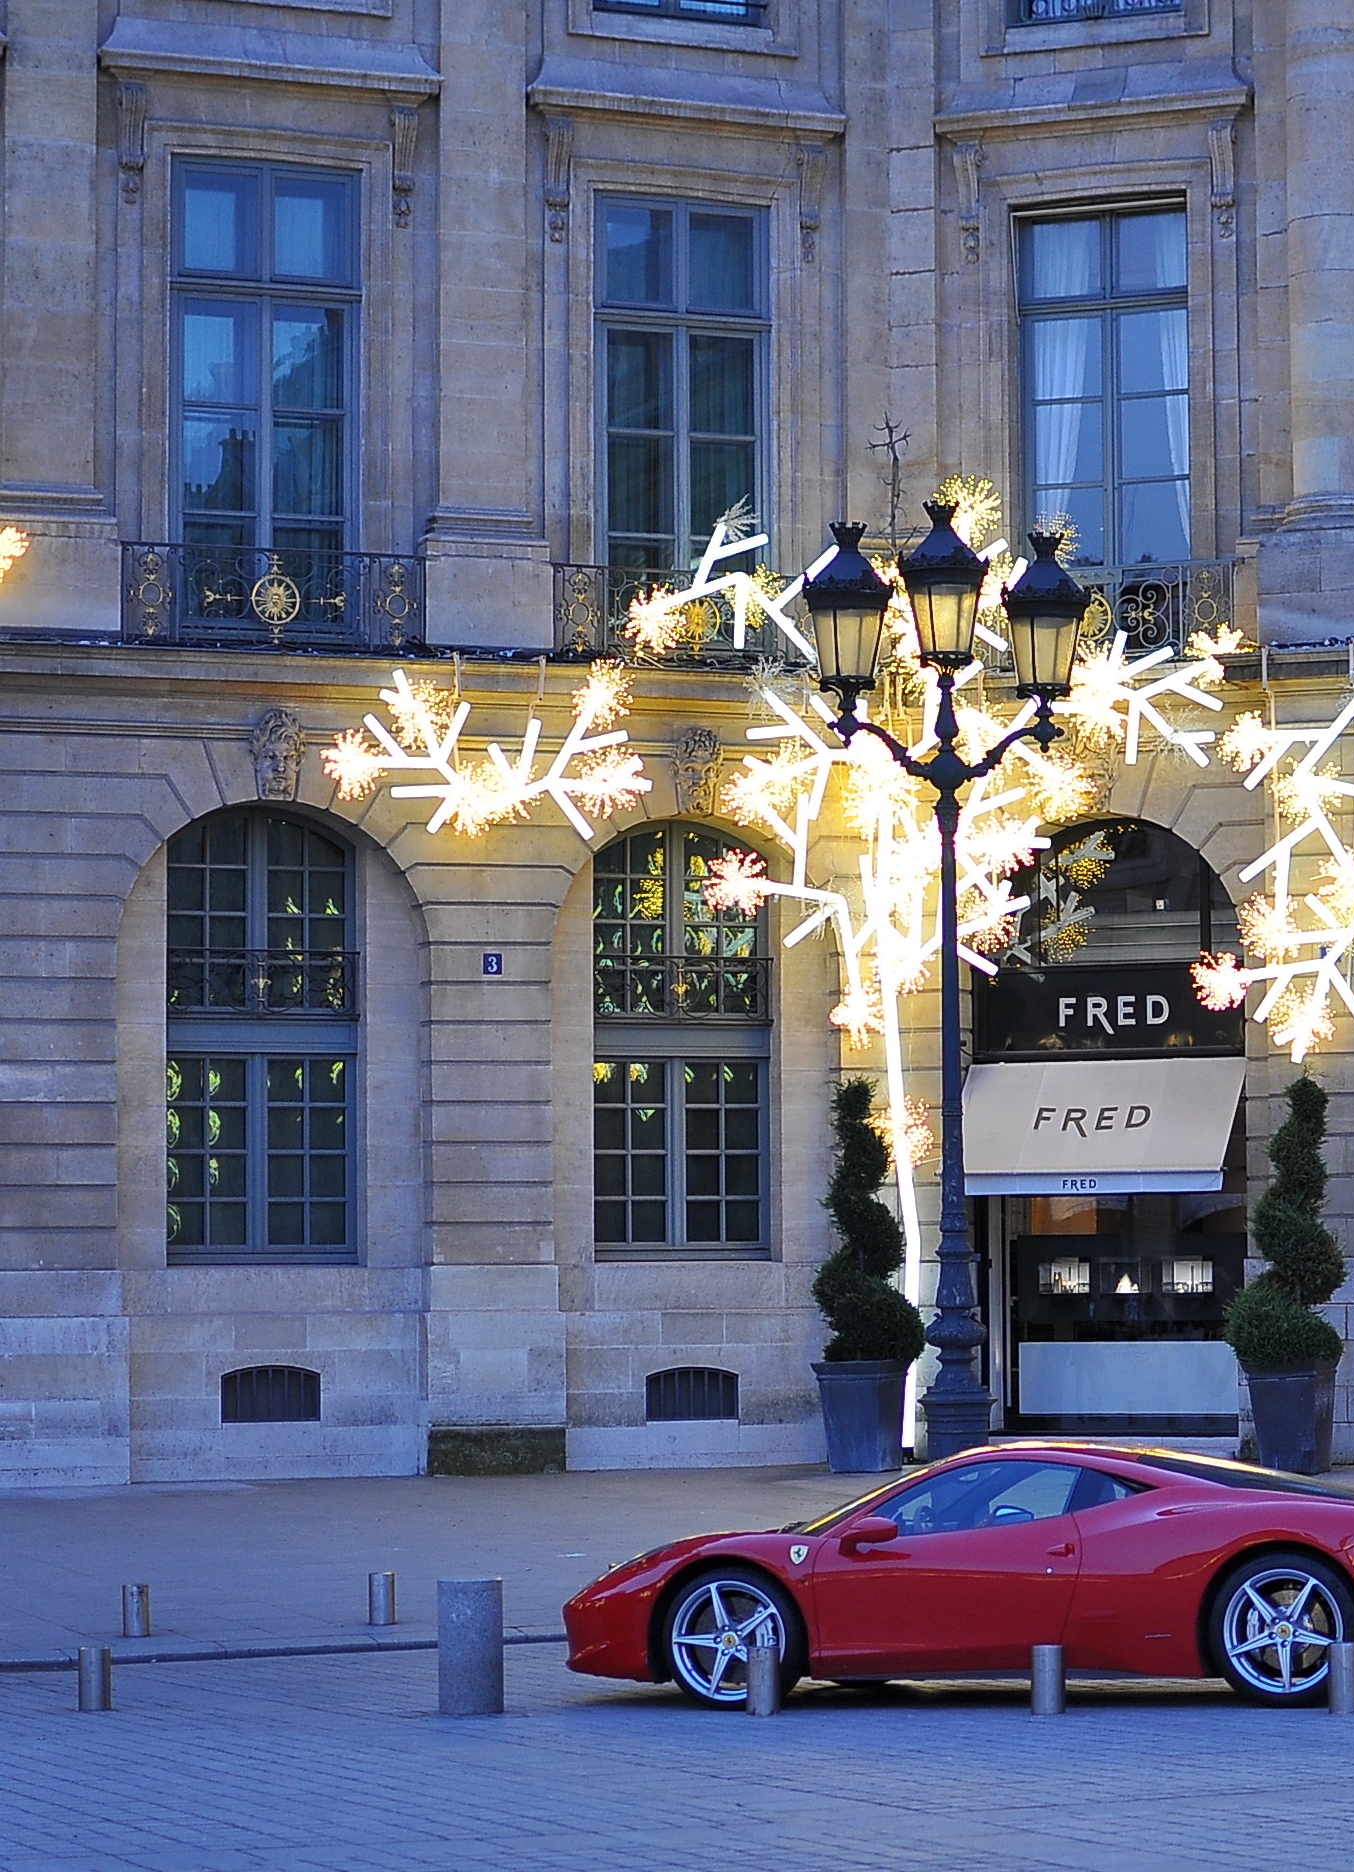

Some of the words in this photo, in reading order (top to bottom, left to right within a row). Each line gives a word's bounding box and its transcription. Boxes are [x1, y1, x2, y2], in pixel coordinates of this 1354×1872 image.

[487, 956, 498, 973] 3
[1058, 994, 1170, 1035] FRED
[1033, 1104, 1152, 1139] FRED
[1061, 1178, 1098, 1192] FRED
